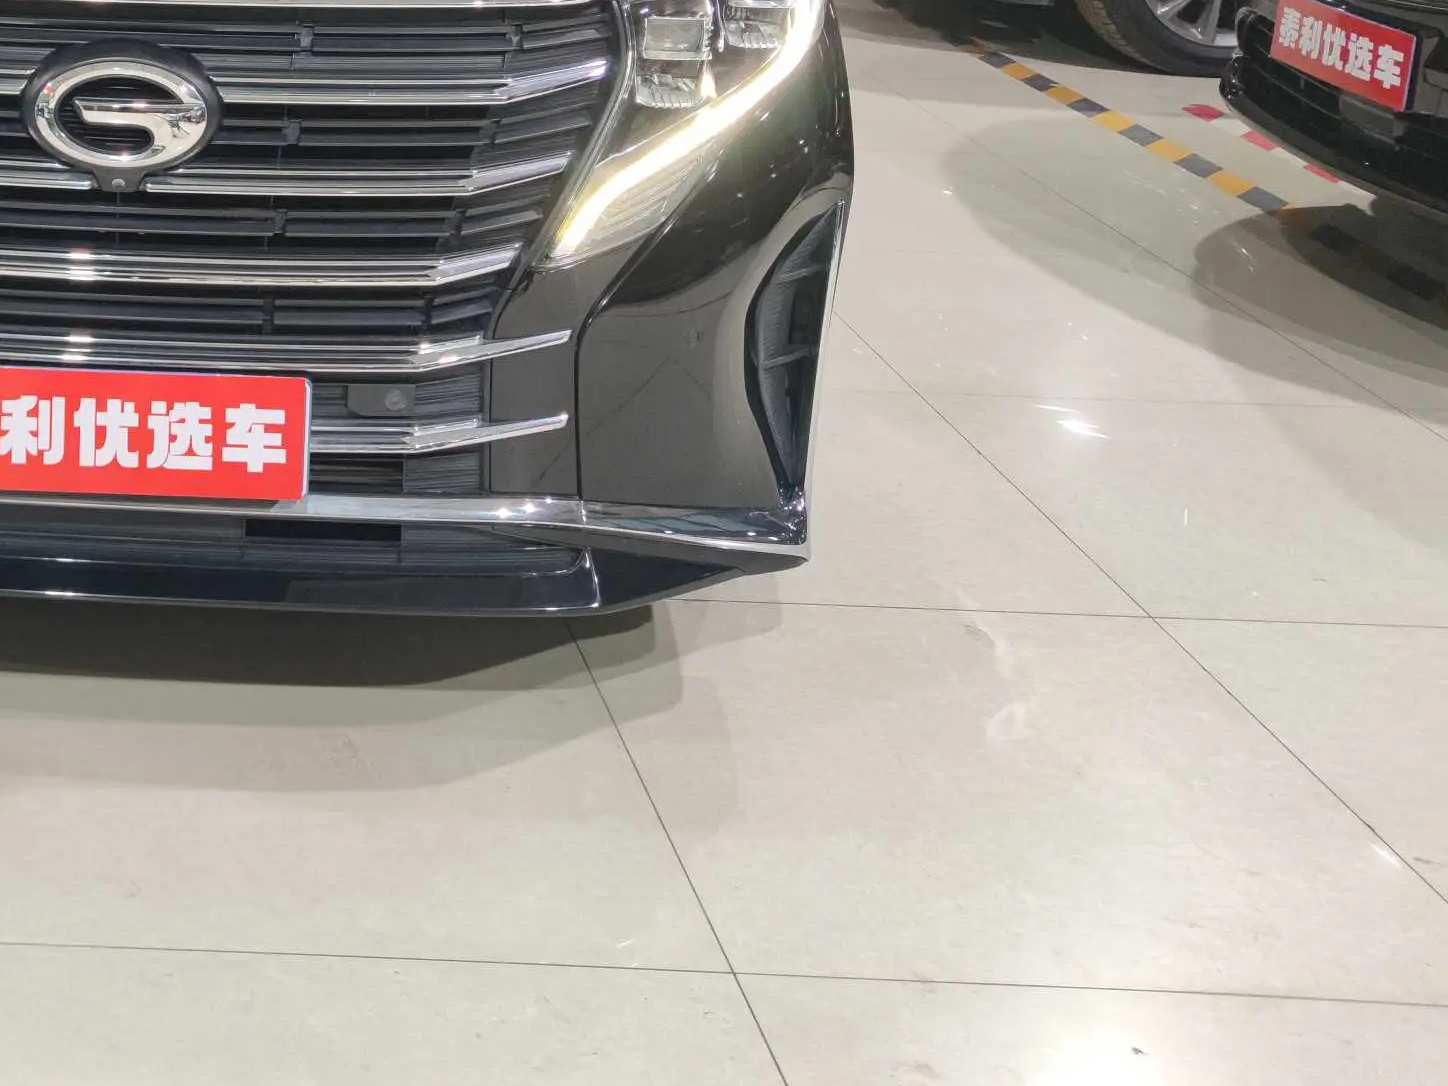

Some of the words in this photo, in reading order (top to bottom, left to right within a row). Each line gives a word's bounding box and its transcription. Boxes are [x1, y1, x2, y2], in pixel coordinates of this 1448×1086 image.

[1279, 6, 1405, 90] 泰利优选车
